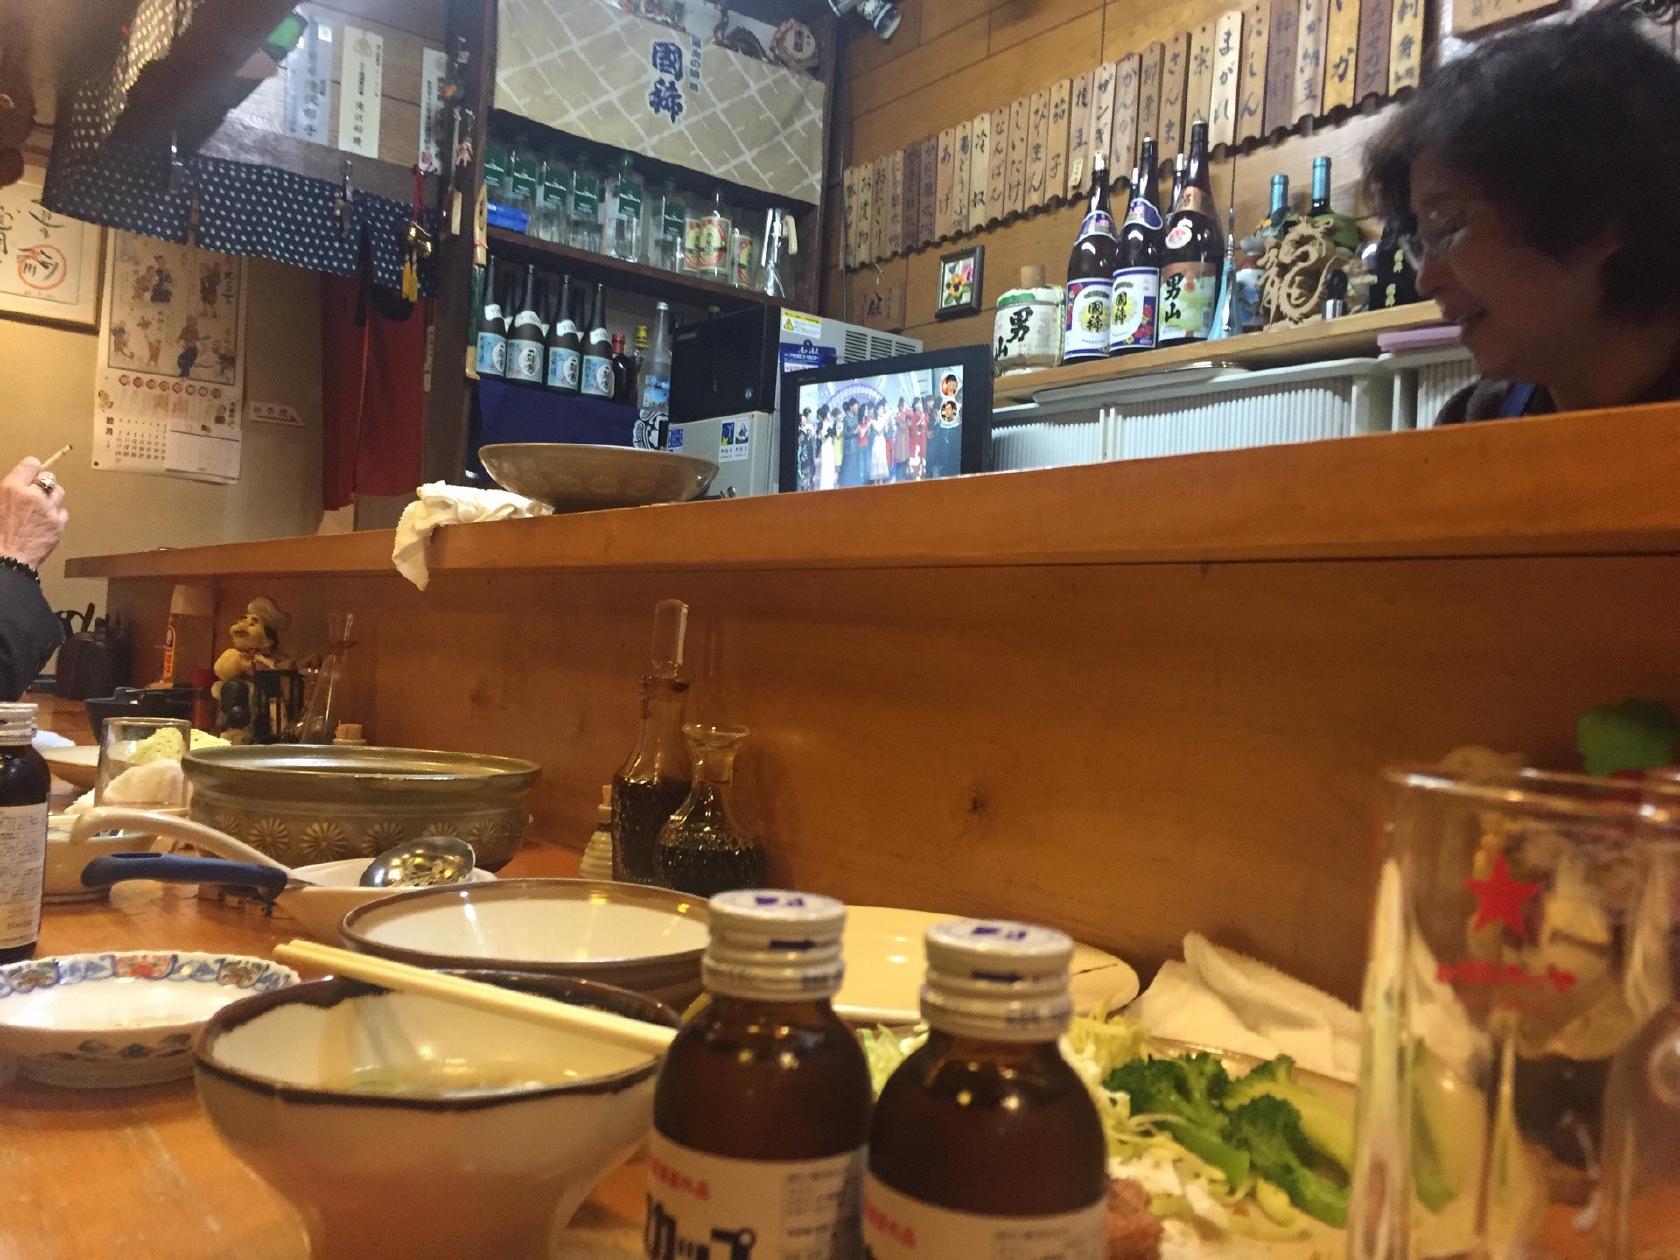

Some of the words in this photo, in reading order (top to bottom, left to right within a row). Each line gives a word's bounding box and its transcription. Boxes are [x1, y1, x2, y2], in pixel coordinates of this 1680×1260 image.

[1163, 51, 1180, 145] さんま
[1007, 109, 1025, 205] しいたけ
[1164, 272, 1185, 323] 男山
